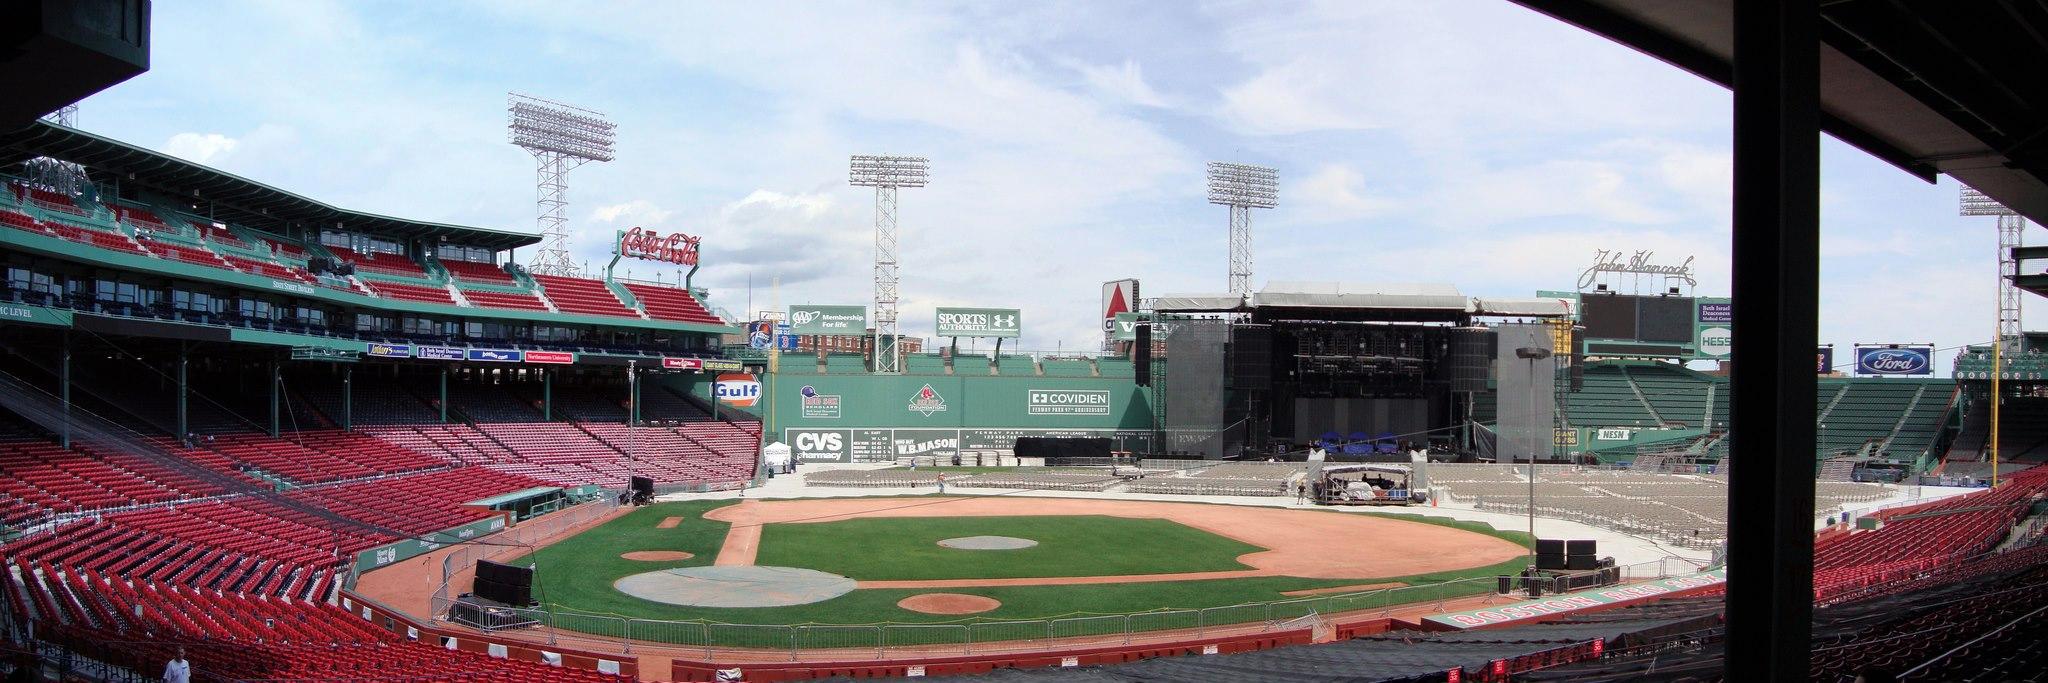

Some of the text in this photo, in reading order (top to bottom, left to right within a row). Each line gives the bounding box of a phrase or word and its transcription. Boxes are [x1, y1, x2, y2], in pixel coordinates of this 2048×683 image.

[622, 226, 701, 265] Coca-Cola
[1578, 248, 1697, 289] John Hancock
[10, 308, 33, 318] LEVEL
[795, 312, 811, 322] AAA
[823, 314, 864, 322] Membership
[939, 313, 987, 324] SPORTS
[1703, 337, 1731, 346] HESS
[1873, 352, 1913, 370] Ford
[715, 384, 759, 397] Gulf
[1050, 394, 1106, 404] COVIDIEN
[796, 432, 843, 451] CVS
[797, 451, 842, 460] pharmacy
[1603, 584, 1671, 601] RED
[1448, 594, 1604, 627] BOSTON
